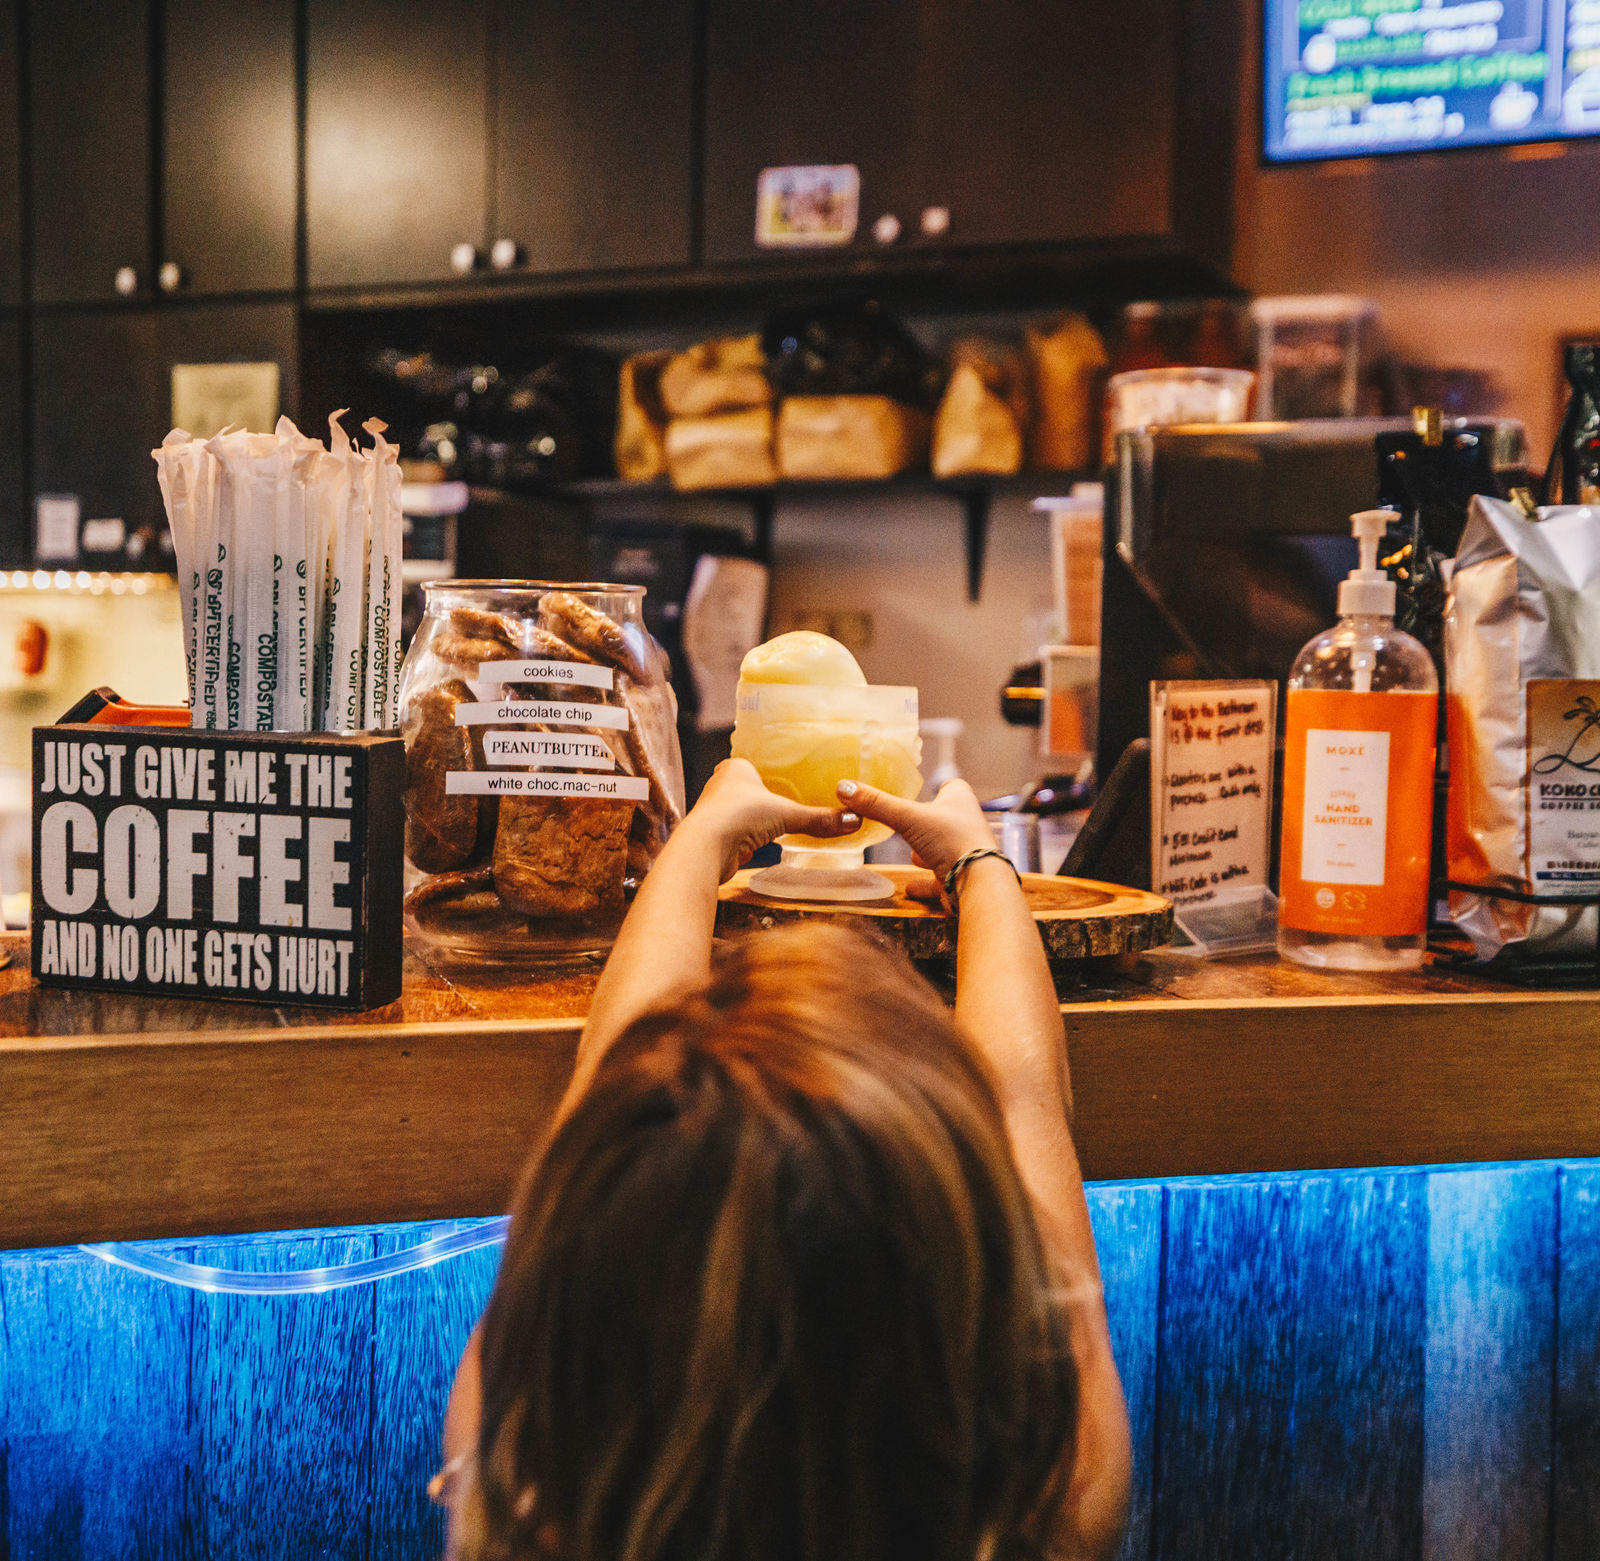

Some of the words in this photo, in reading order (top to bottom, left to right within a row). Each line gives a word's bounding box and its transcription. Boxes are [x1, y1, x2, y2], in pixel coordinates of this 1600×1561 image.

[373, 605, 386, 720] COMPOSTABLE
[523, 665, 574, 679] cookies
[497, 706, 562, 720] chocolate
[565, 709, 593, 721] chip
[41, 741, 127, 797] JUST
[135, 745, 216, 801] GIVE
[224, 750, 278, 805] ME
[284, 753, 353, 809] THE
[487, 777, 523, 790] white
[527, 778, 617, 793] choc.mac-nut
[1540, 784, 1587, 797] KOKO
[1326, 804, 1360, 814] HAND
[1314, 815, 1373, 826] SANITIZER
[40, 801, 353, 932] COFFEE
[40, 920, 97, 978] AND
[102, 923, 140, 983] NO
[145, 926, 199, 985] ONE
[203, 929, 273, 992] GETS
[278, 935, 354, 997] HURT
